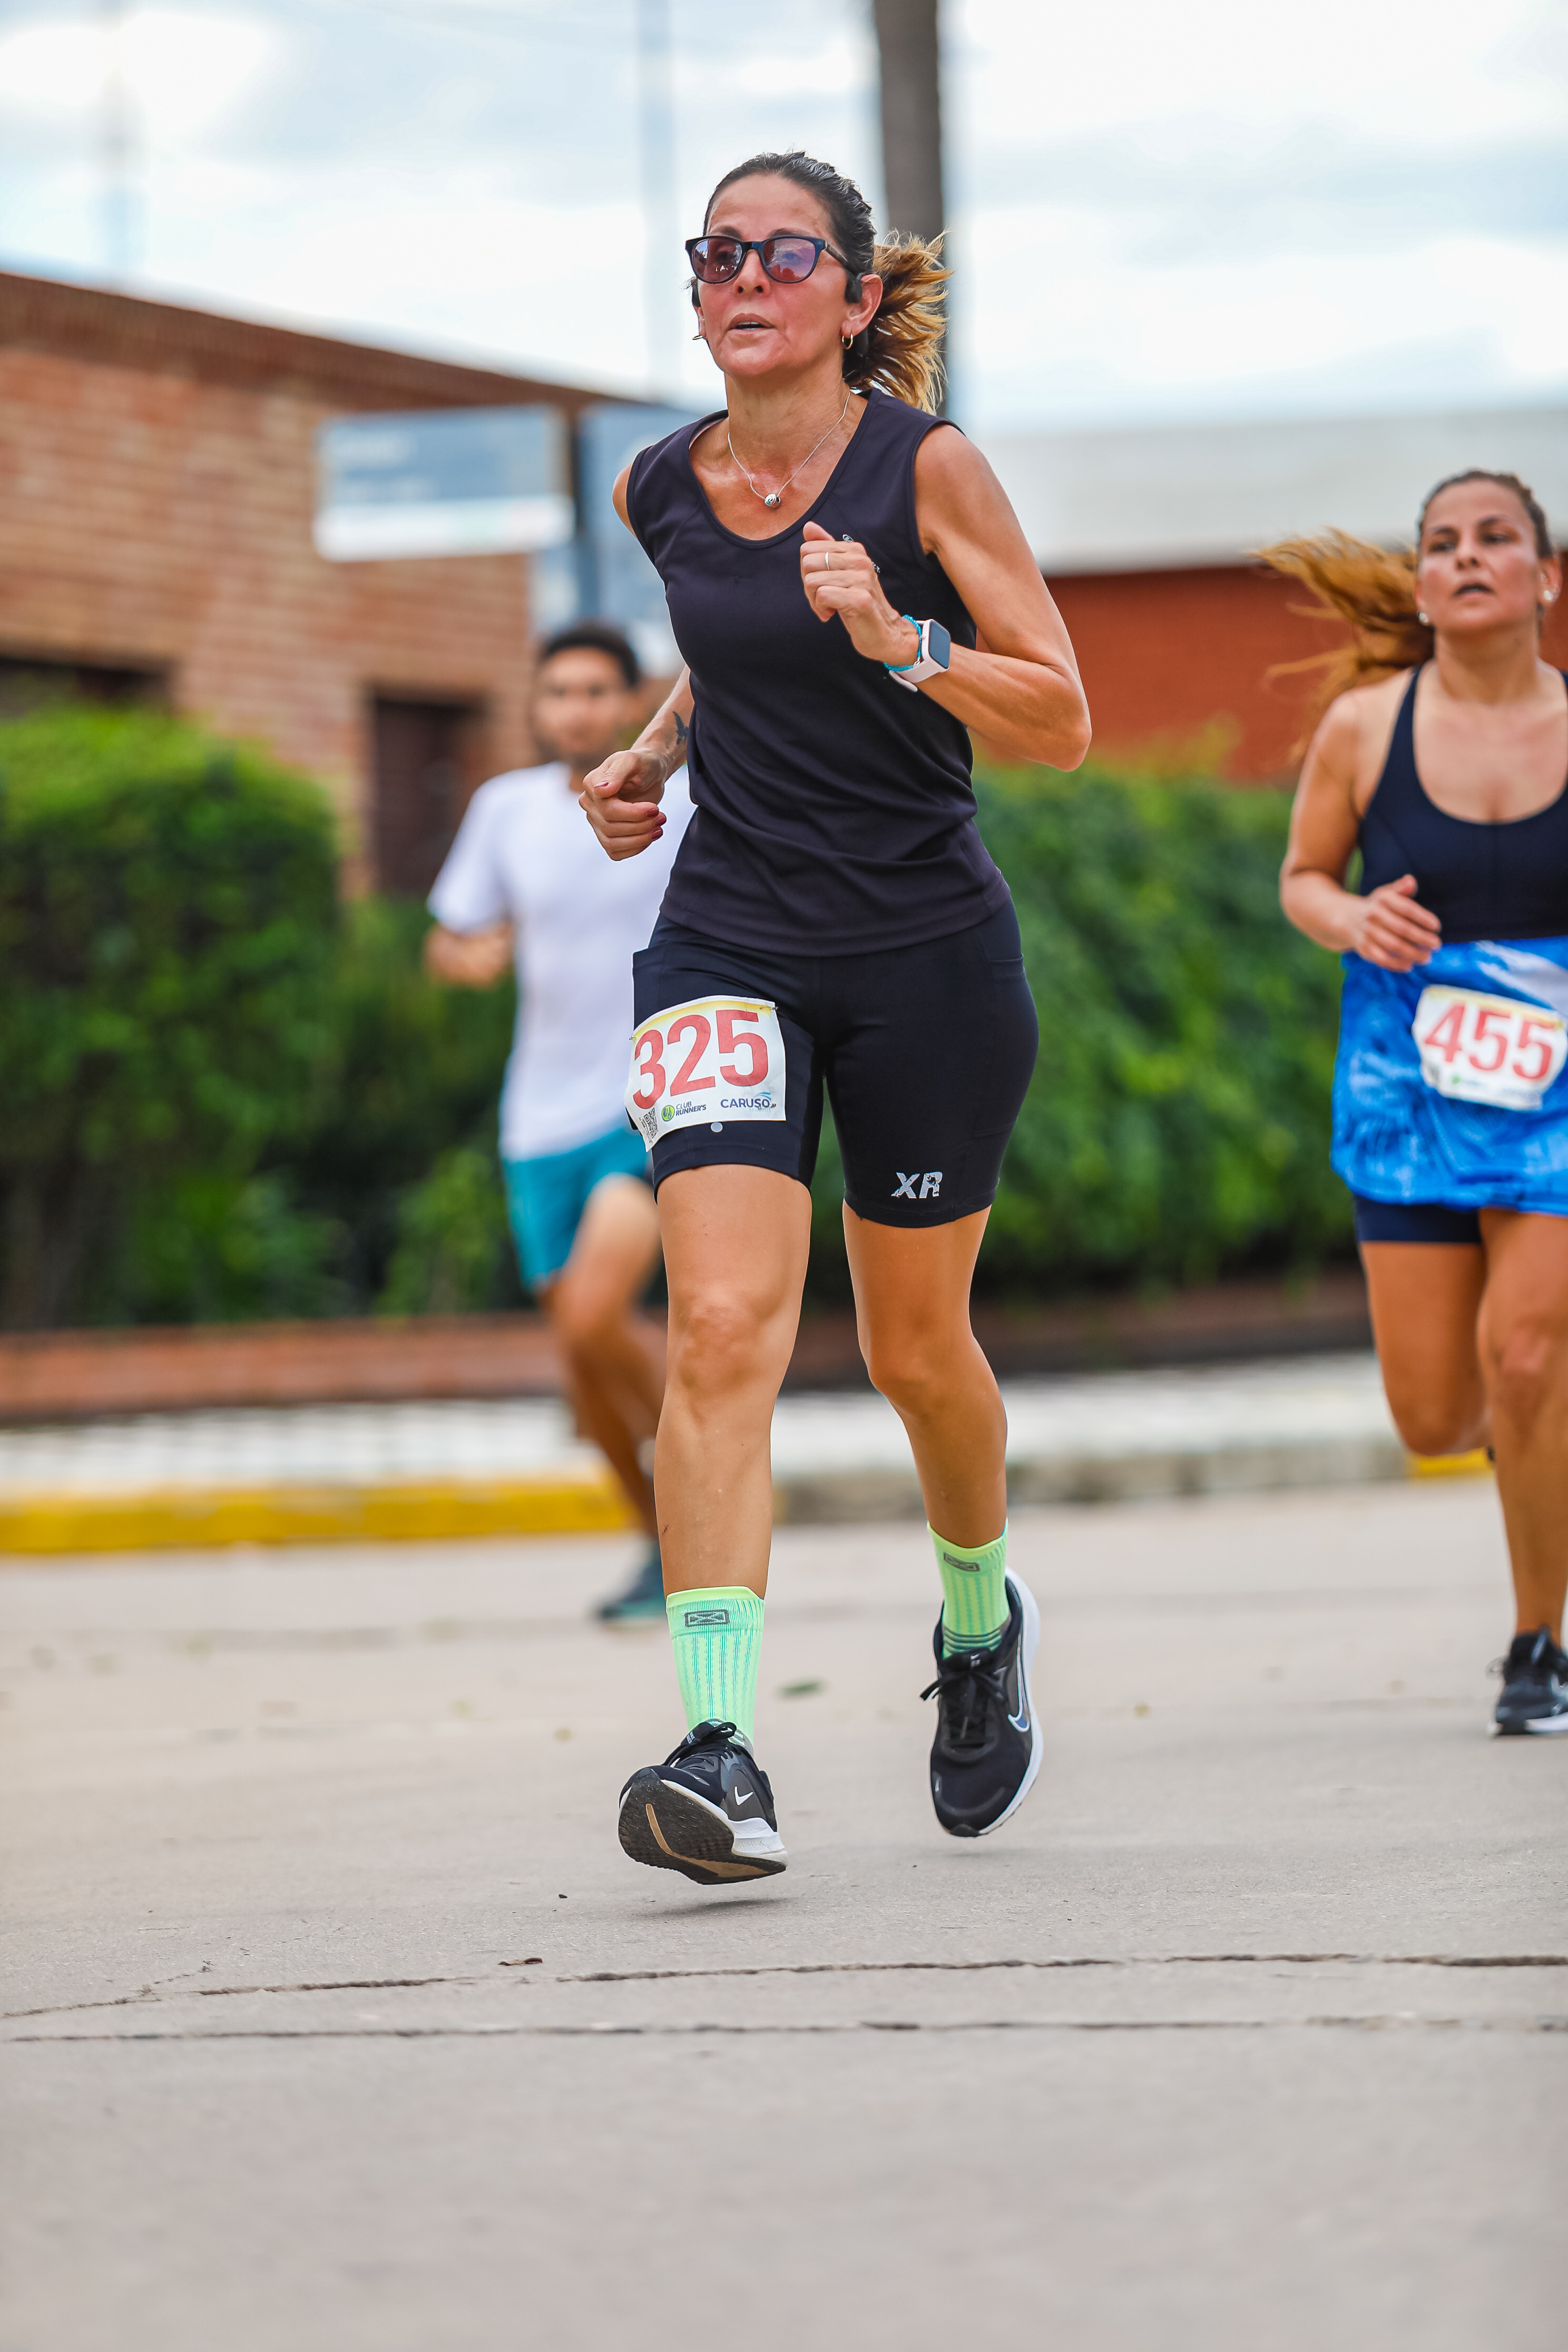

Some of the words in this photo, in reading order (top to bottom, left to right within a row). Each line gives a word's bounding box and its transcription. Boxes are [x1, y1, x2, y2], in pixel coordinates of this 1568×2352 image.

[1424, 1001, 1556, 1080] 455
[633, 1010, 769, 1110] 325
[675, 1104, 707, 1116] RUNNER'S
[676, 1101, 692, 1110] CLUB
[720, 1098, 770, 1109] CARUSO
[891, 1171, 943, 1199] XR
